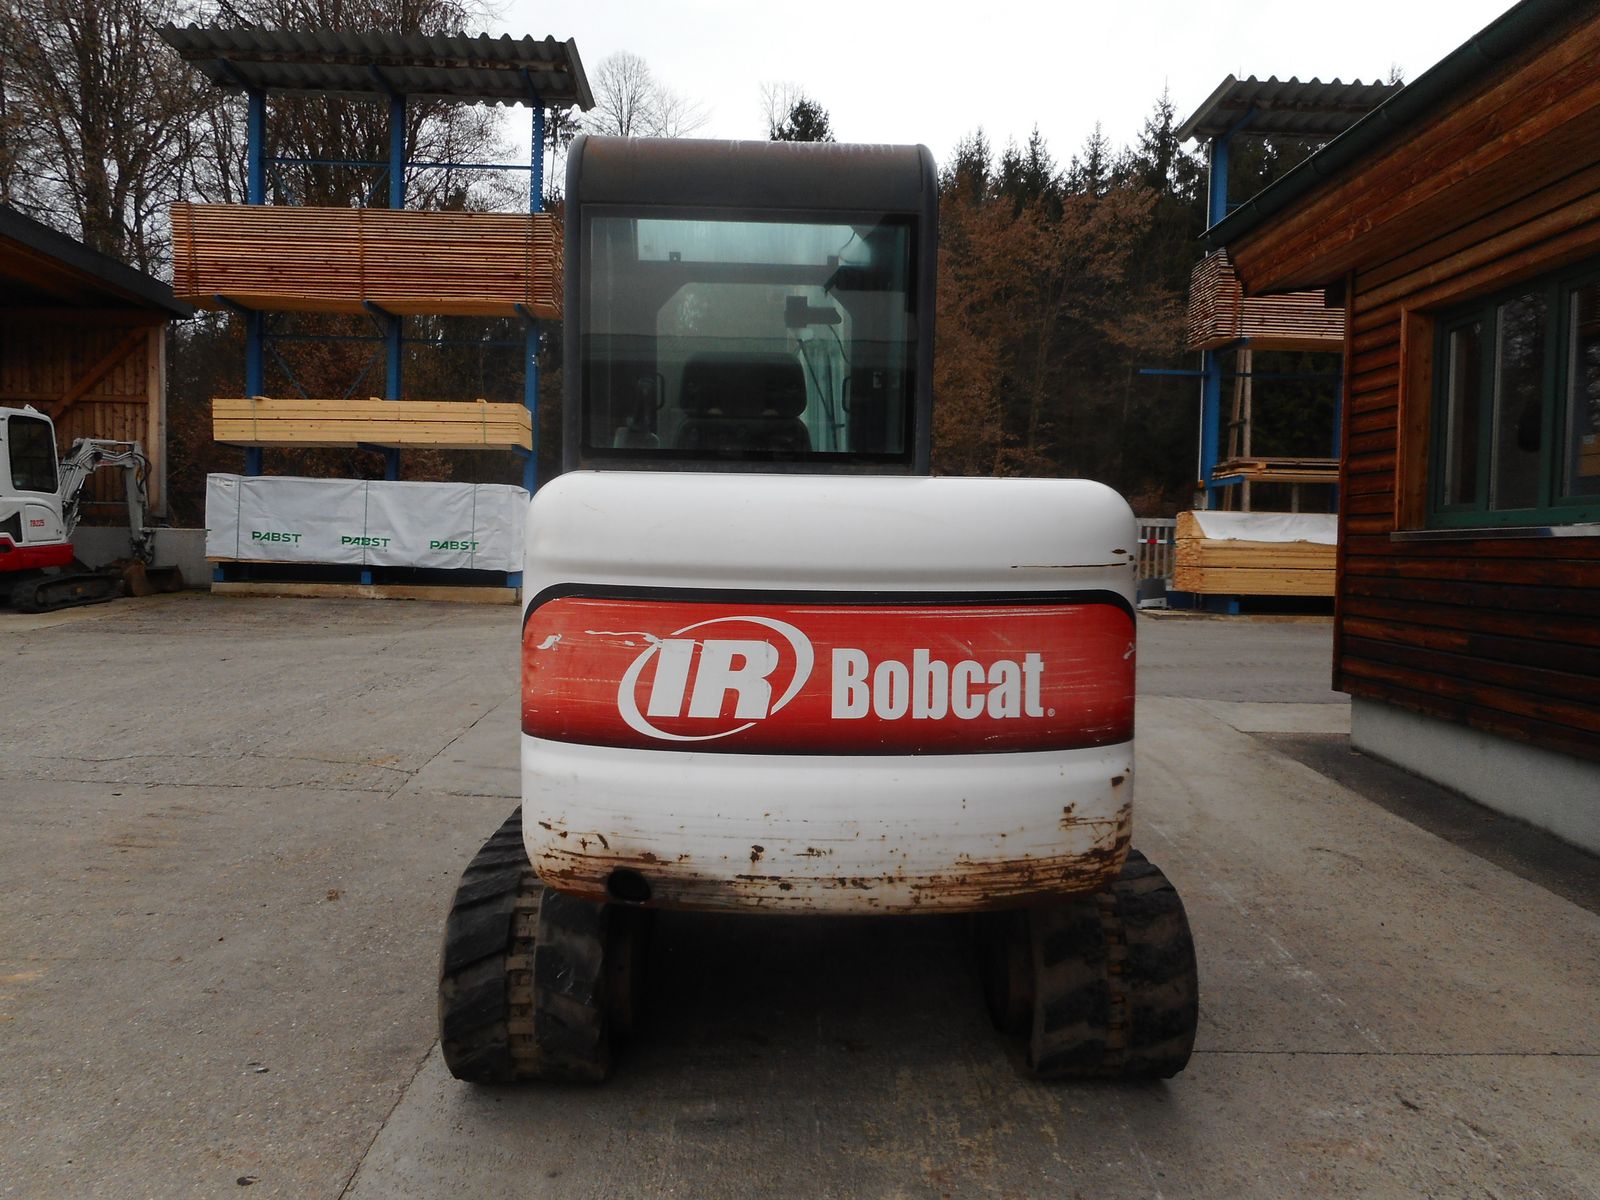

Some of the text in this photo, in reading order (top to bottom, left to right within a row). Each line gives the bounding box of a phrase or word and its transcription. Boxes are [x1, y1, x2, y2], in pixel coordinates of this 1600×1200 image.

[252, 531, 302, 543] PABST
[341, 536, 391, 547] PABST
[430, 540, 479, 551] PABST
[647, 638, 1045, 721] IR Bobcat
